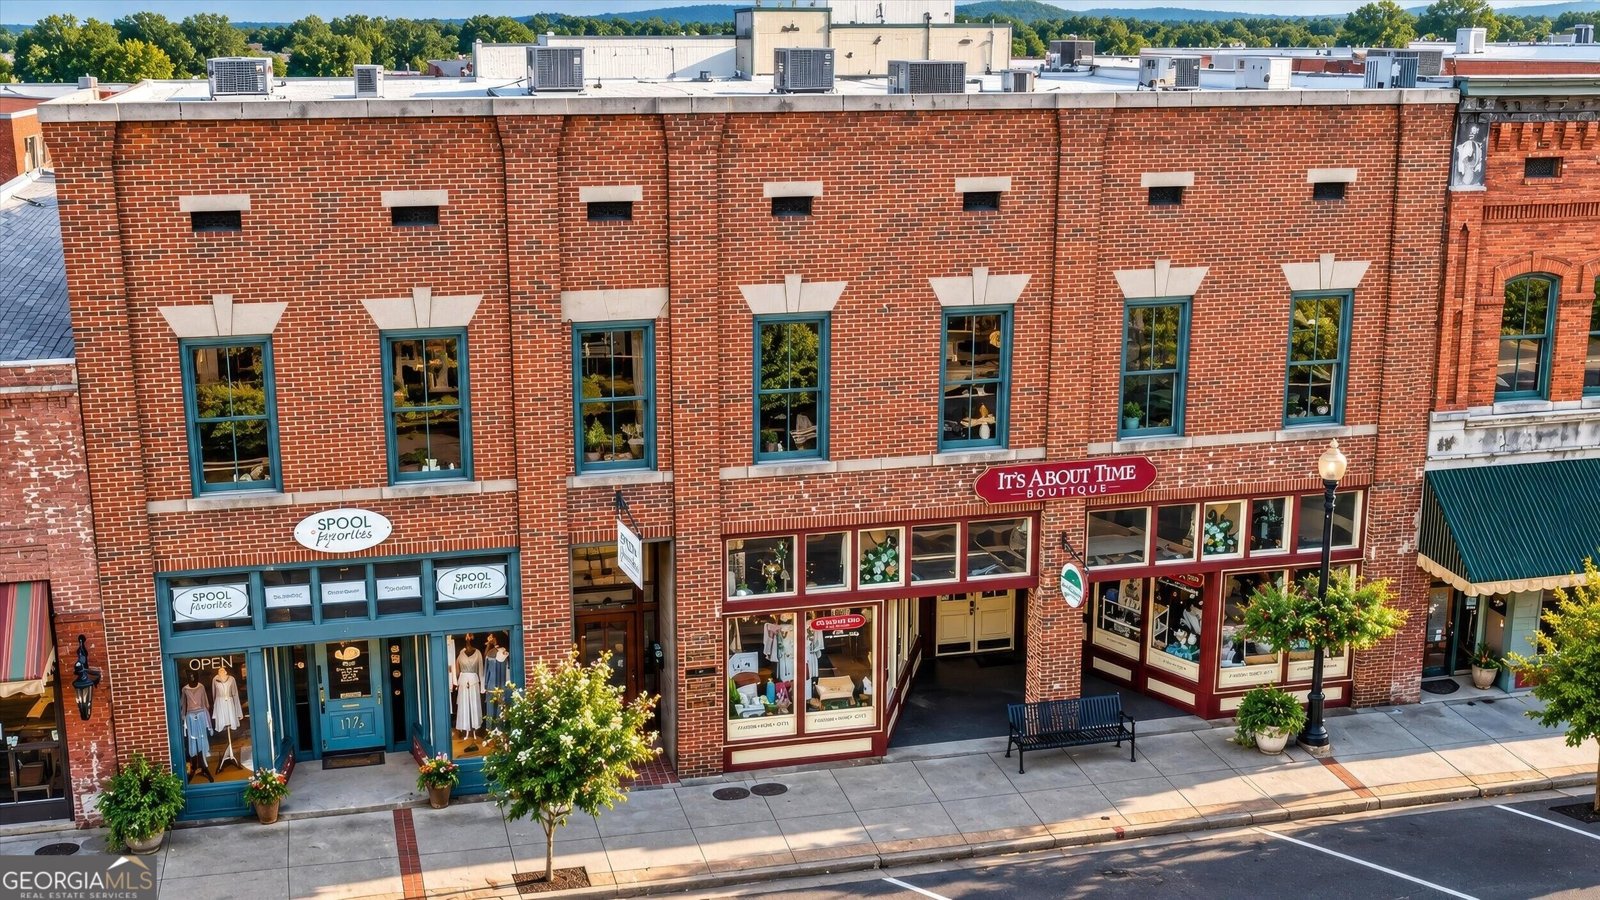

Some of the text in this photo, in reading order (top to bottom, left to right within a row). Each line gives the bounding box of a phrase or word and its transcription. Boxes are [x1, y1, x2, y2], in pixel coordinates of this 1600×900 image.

[997, 464, 1136, 490] IT'S ABOUT TIME
[317, 515, 372, 531] SPOOL
[455, 572, 491, 583] SPOOL
[192, 590, 232, 602] SPOOL
[189, 655, 233, 671] OPEN
